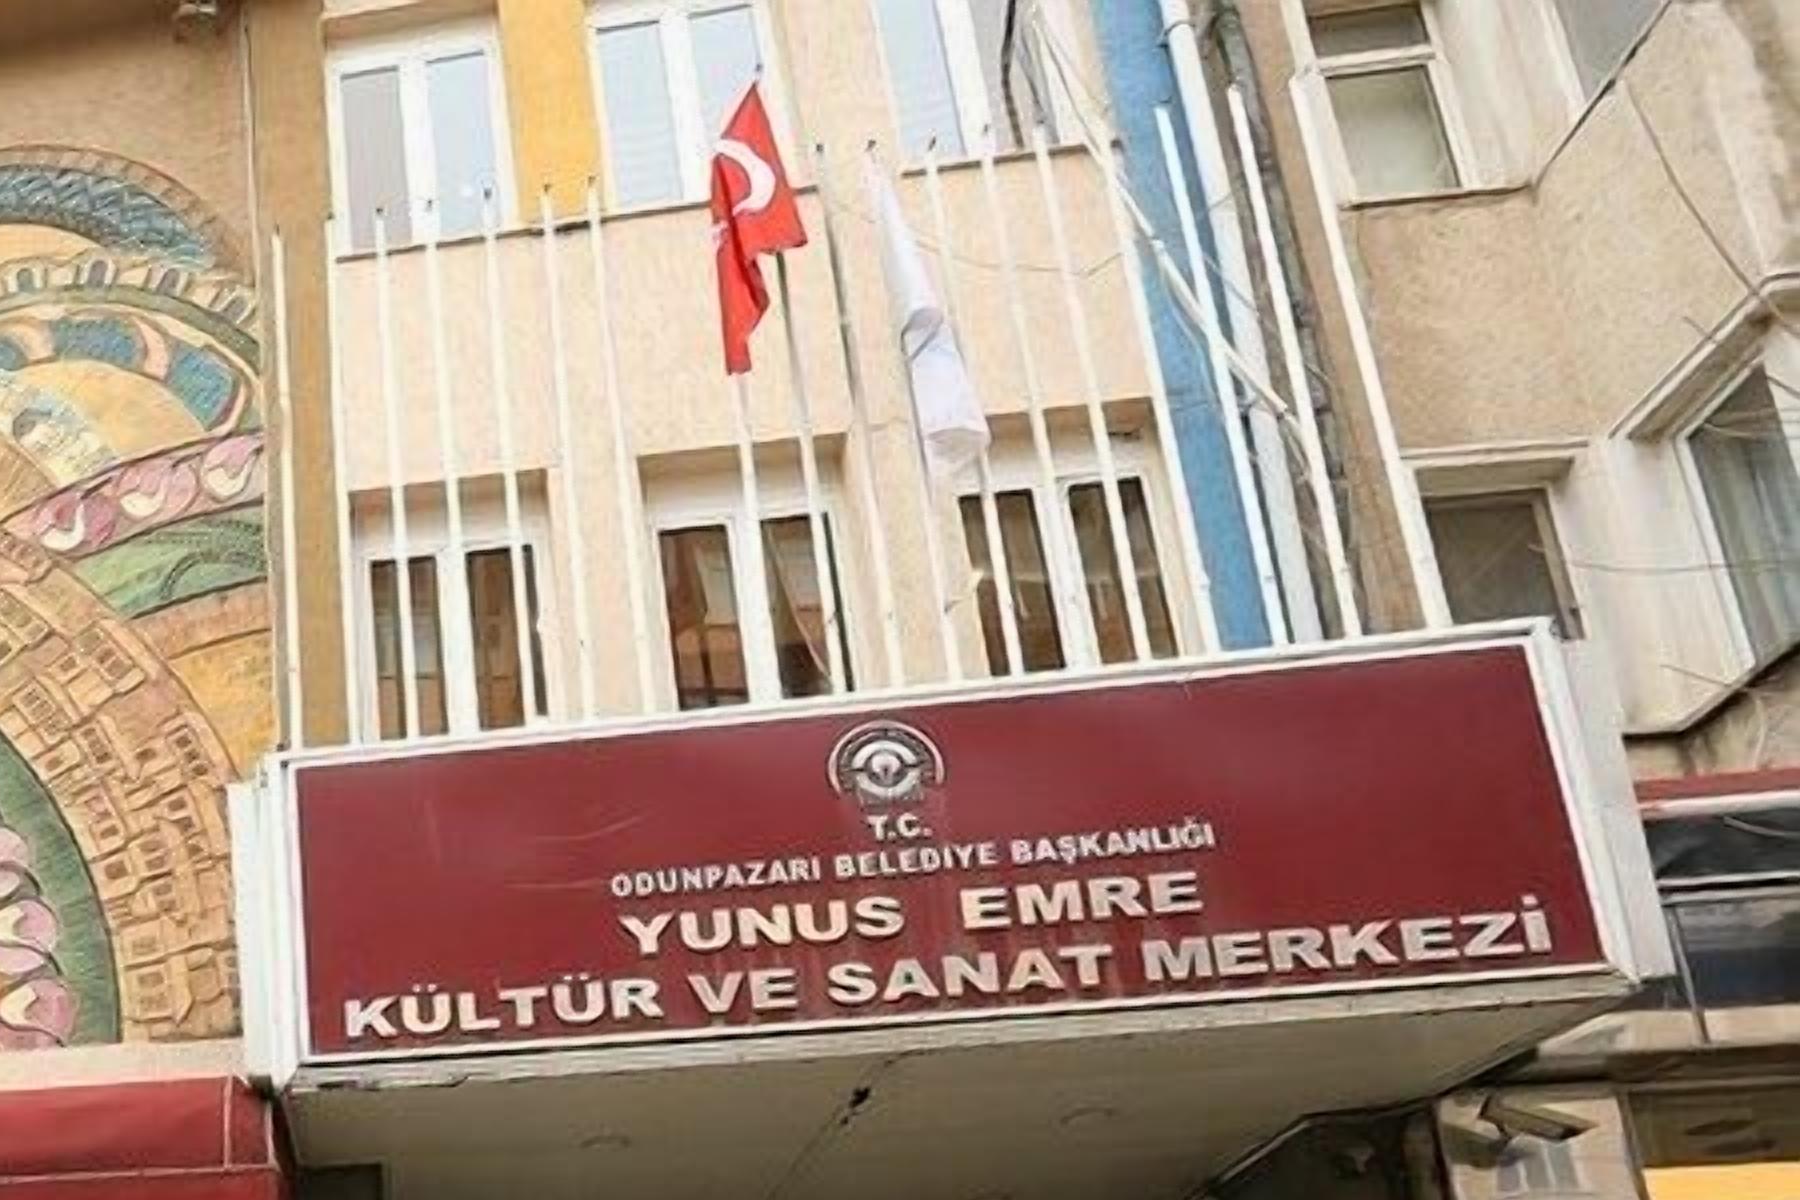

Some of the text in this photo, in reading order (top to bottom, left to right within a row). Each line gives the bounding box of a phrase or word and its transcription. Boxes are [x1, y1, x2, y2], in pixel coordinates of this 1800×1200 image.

[611, 854, 821, 897] ODUNPAZARI
[1010, 818, 1215, 866] BAŞKANLIĞI
[867, 812, 932, 840] T.C.
[619, 872, 1202, 955] YUNUS EMRE
[344, 896, 1552, 1038] KÜLTÜR VE SANAT MERKEZİ
